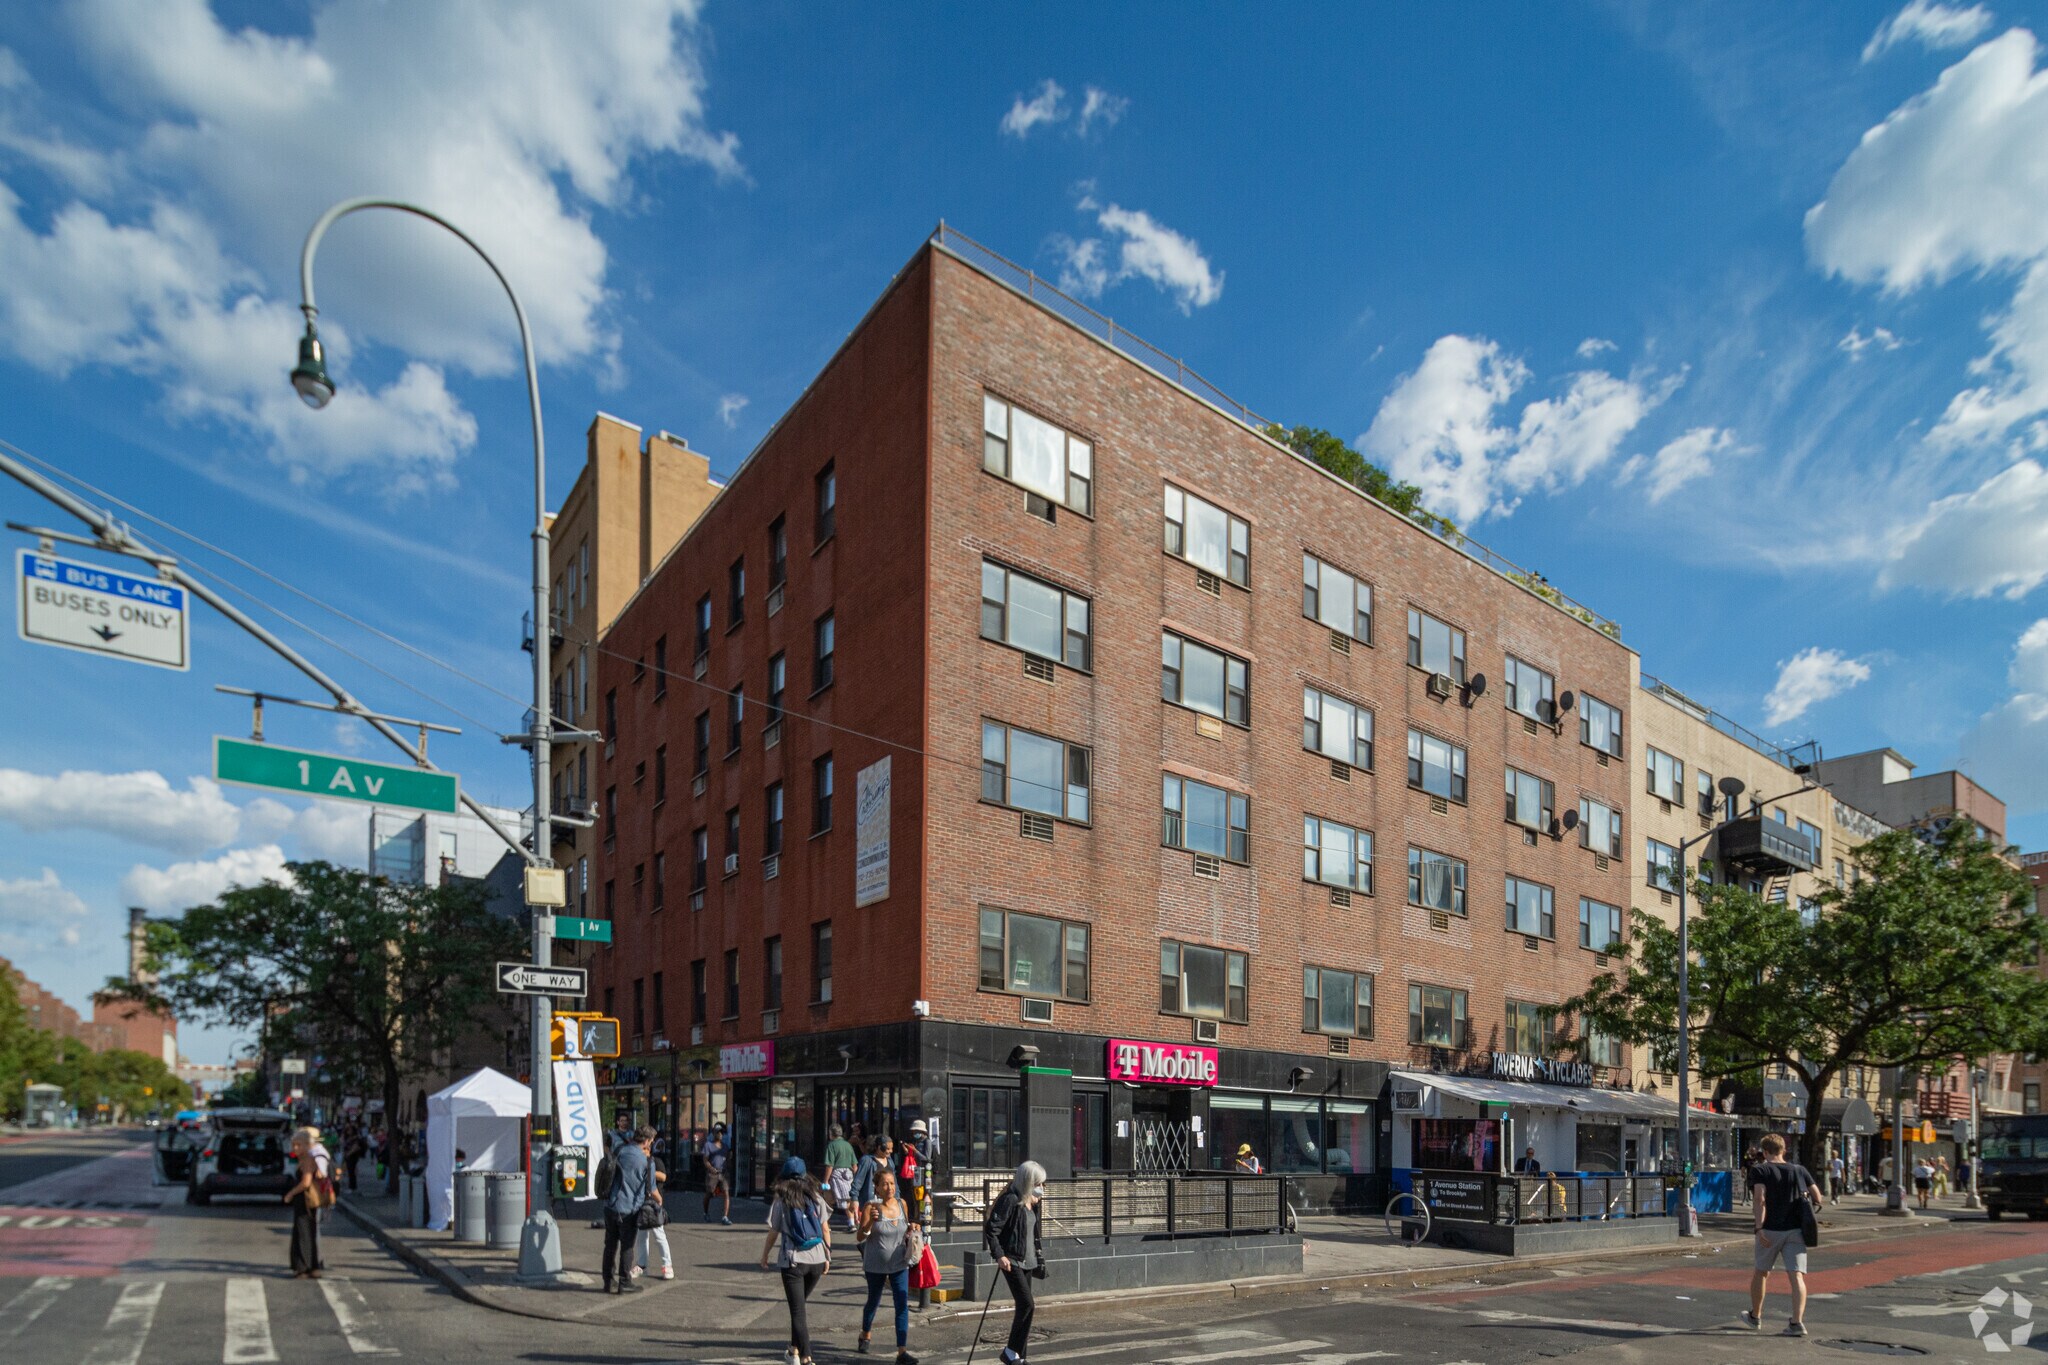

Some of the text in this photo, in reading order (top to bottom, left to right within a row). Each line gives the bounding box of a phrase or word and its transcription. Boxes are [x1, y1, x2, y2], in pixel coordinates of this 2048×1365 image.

[66, 567, 173, 605] BUS LANE
[34, 586, 173, 630] BUSES ONLY
[298, 760, 385, 796] 1 Av
[580, 920, 600, 937] 1 Av
[512, 972, 575, 987] ONE WAY
[1140, 1046, 1216, 1081] Mobile
[1492, 1052, 1593, 1085] TAVERNA KYCLADES
[1434, 1181, 1457, 1189] Avenue
[1458, 1182, 1481, 1191] Station
[1446, 1189, 1467, 1197] Brooklyn
